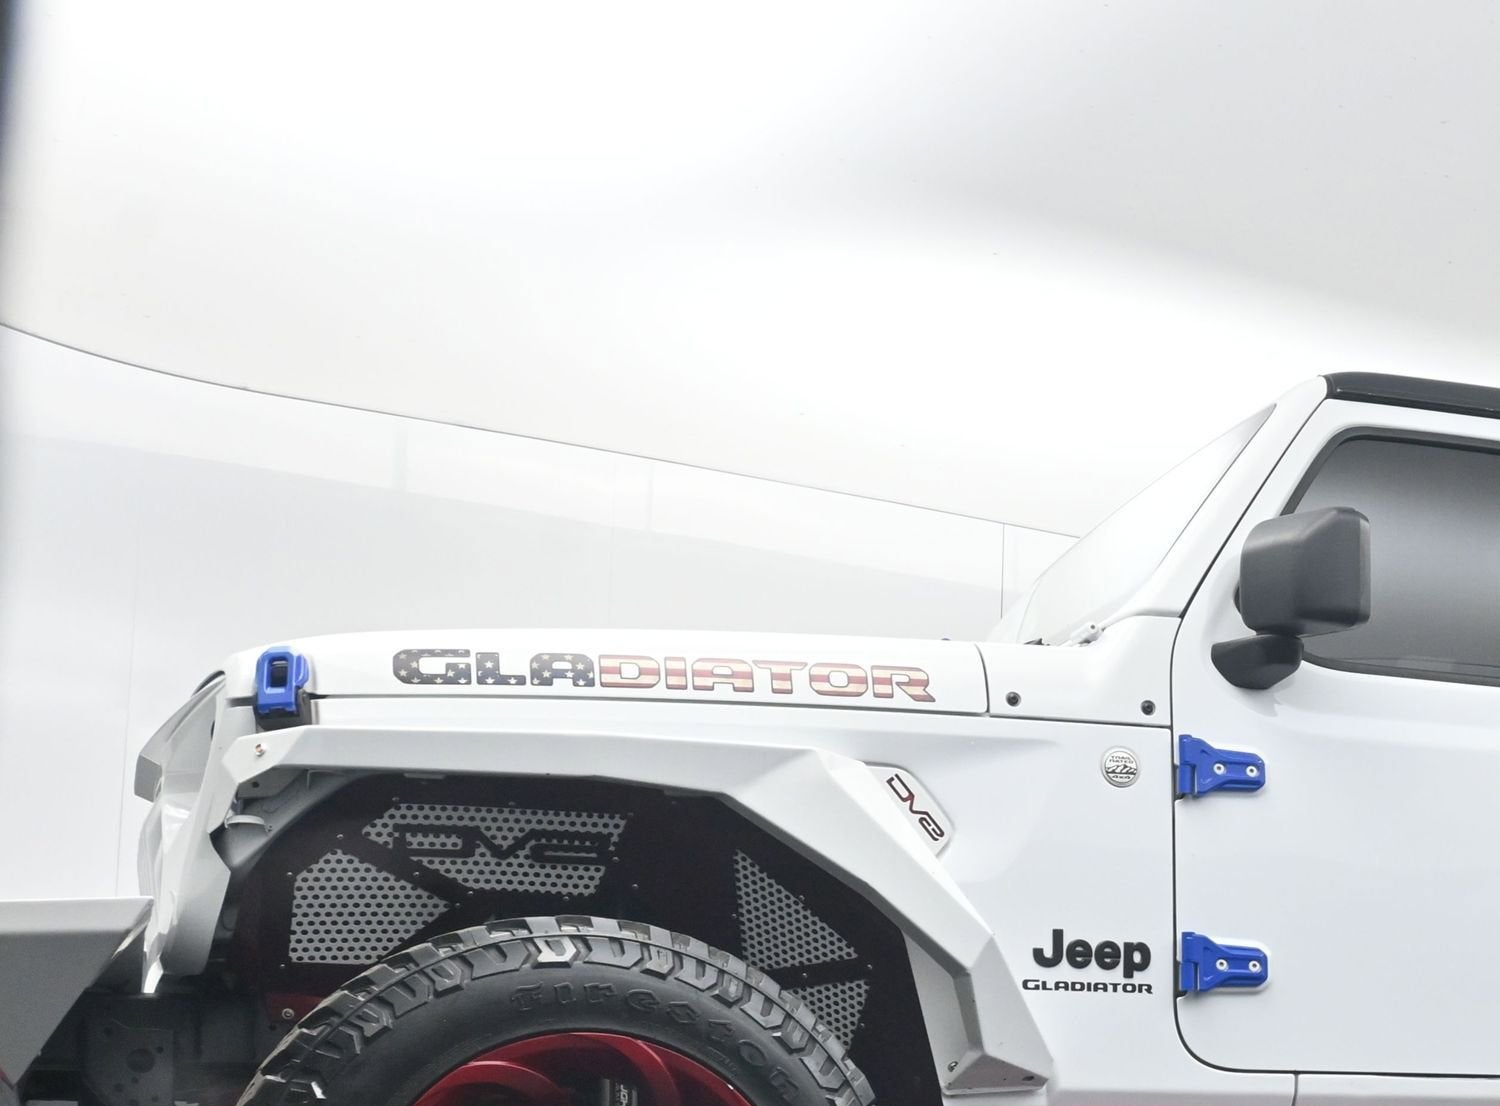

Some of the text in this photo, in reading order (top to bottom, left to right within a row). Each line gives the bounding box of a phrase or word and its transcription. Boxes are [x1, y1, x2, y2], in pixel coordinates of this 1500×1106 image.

[392, 648, 937, 703] GLADIATOR
[1032, 928, 1152, 978] Jeep
[1022, 979, 1153, 994] GLADIATOR
